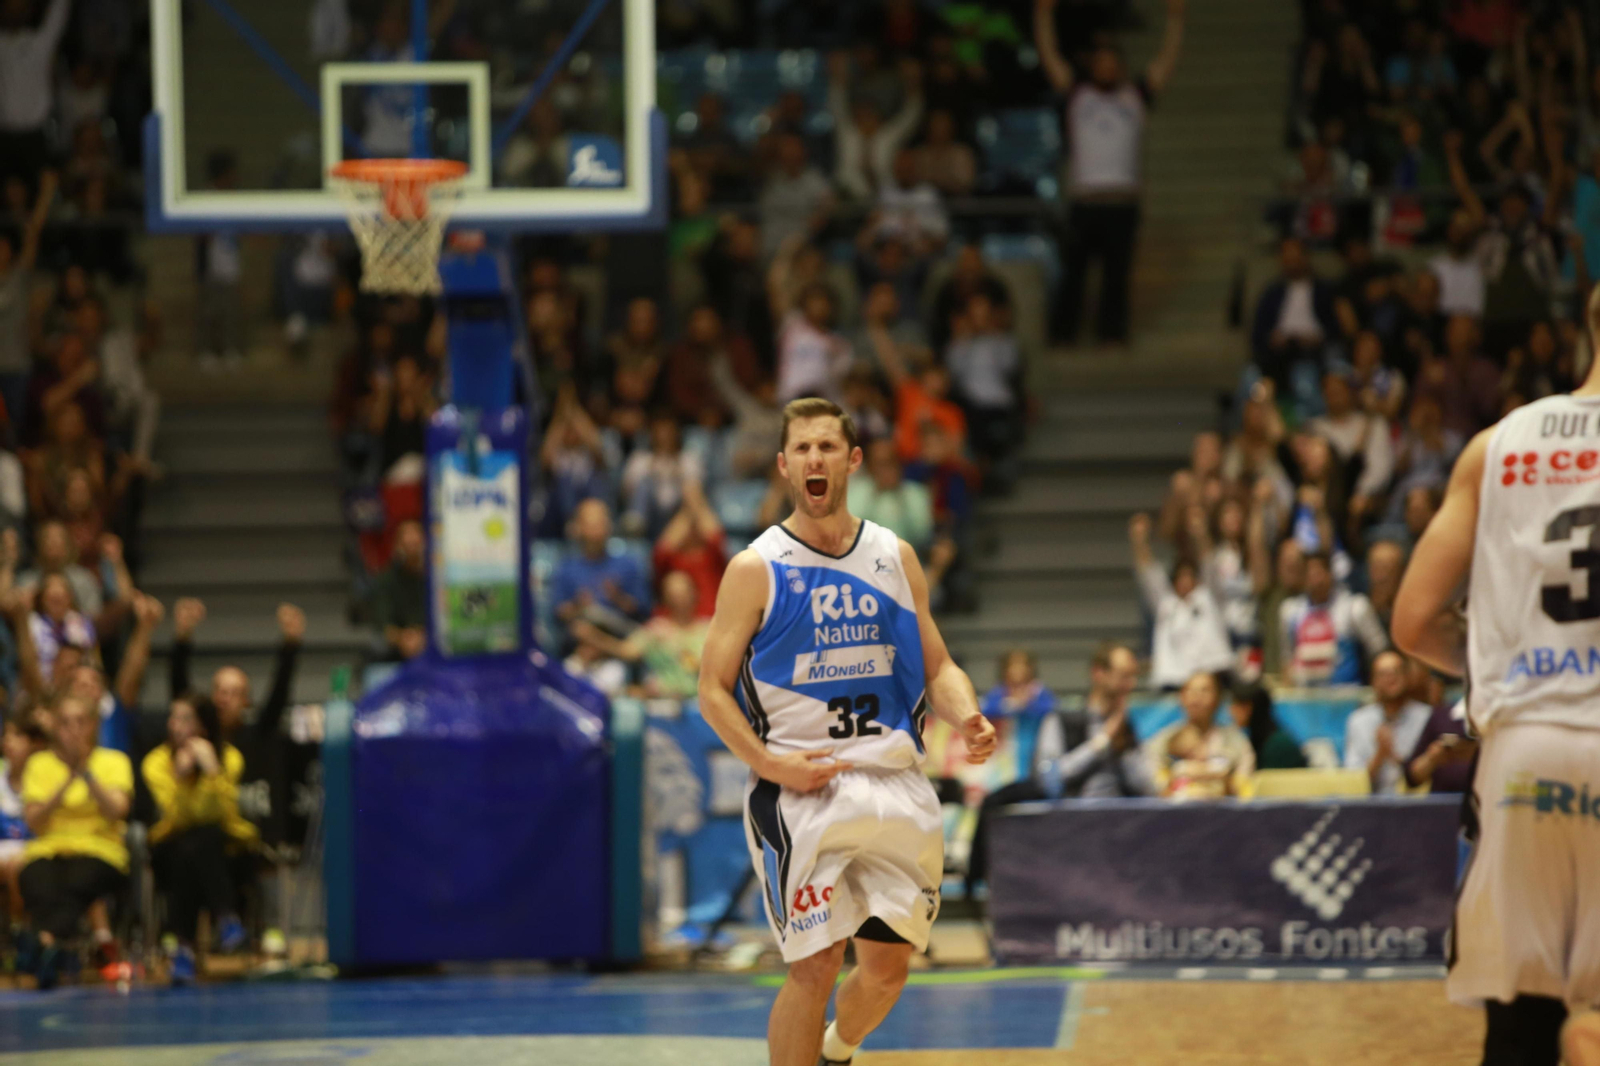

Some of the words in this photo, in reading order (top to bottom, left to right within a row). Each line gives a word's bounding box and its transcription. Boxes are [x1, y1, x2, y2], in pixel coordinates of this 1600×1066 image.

[811, 583, 879, 624] Rio
[814, 623, 880, 646] Natura
[808, 659, 876, 680] MONBUS
[827, 693, 882, 739] 32
[1055, 921, 1264, 960] Multiusos
[1279, 920, 1428, 960] Fontes
